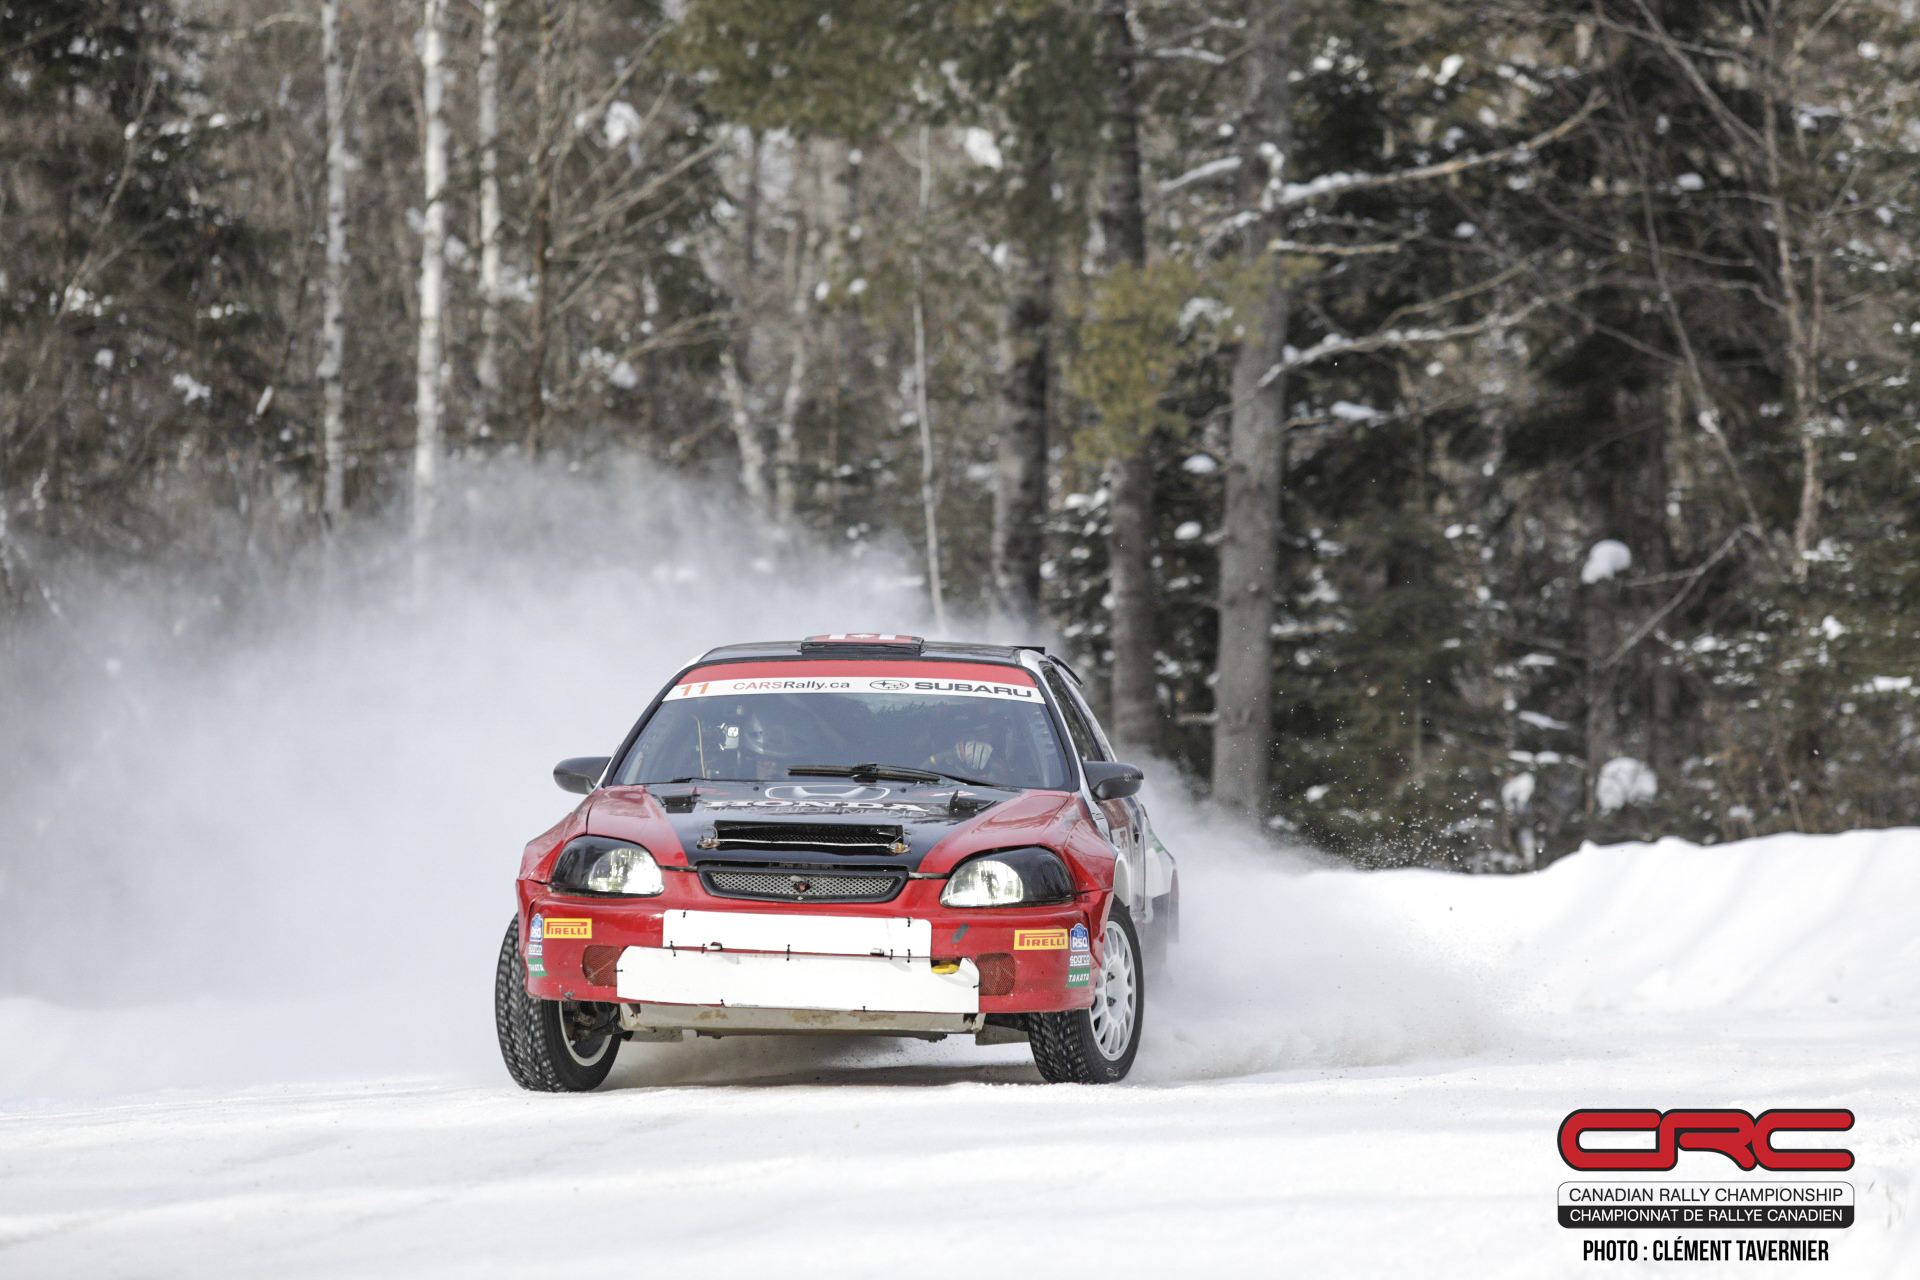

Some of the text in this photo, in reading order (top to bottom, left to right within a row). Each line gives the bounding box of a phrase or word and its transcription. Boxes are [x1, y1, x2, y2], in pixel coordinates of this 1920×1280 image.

[680, 681, 1032, 698] 11 CARSRally.ca SUBARU
[706, 801, 930, 811] HONDA
[546, 922, 588, 935] PIRELLI
[1018, 932, 1065, 947] PIRELLI
[1072, 936, 1088, 948] RSQ
[1069, 955, 1090, 967] sparco
[1068, 973, 1090, 983] TAKATA
